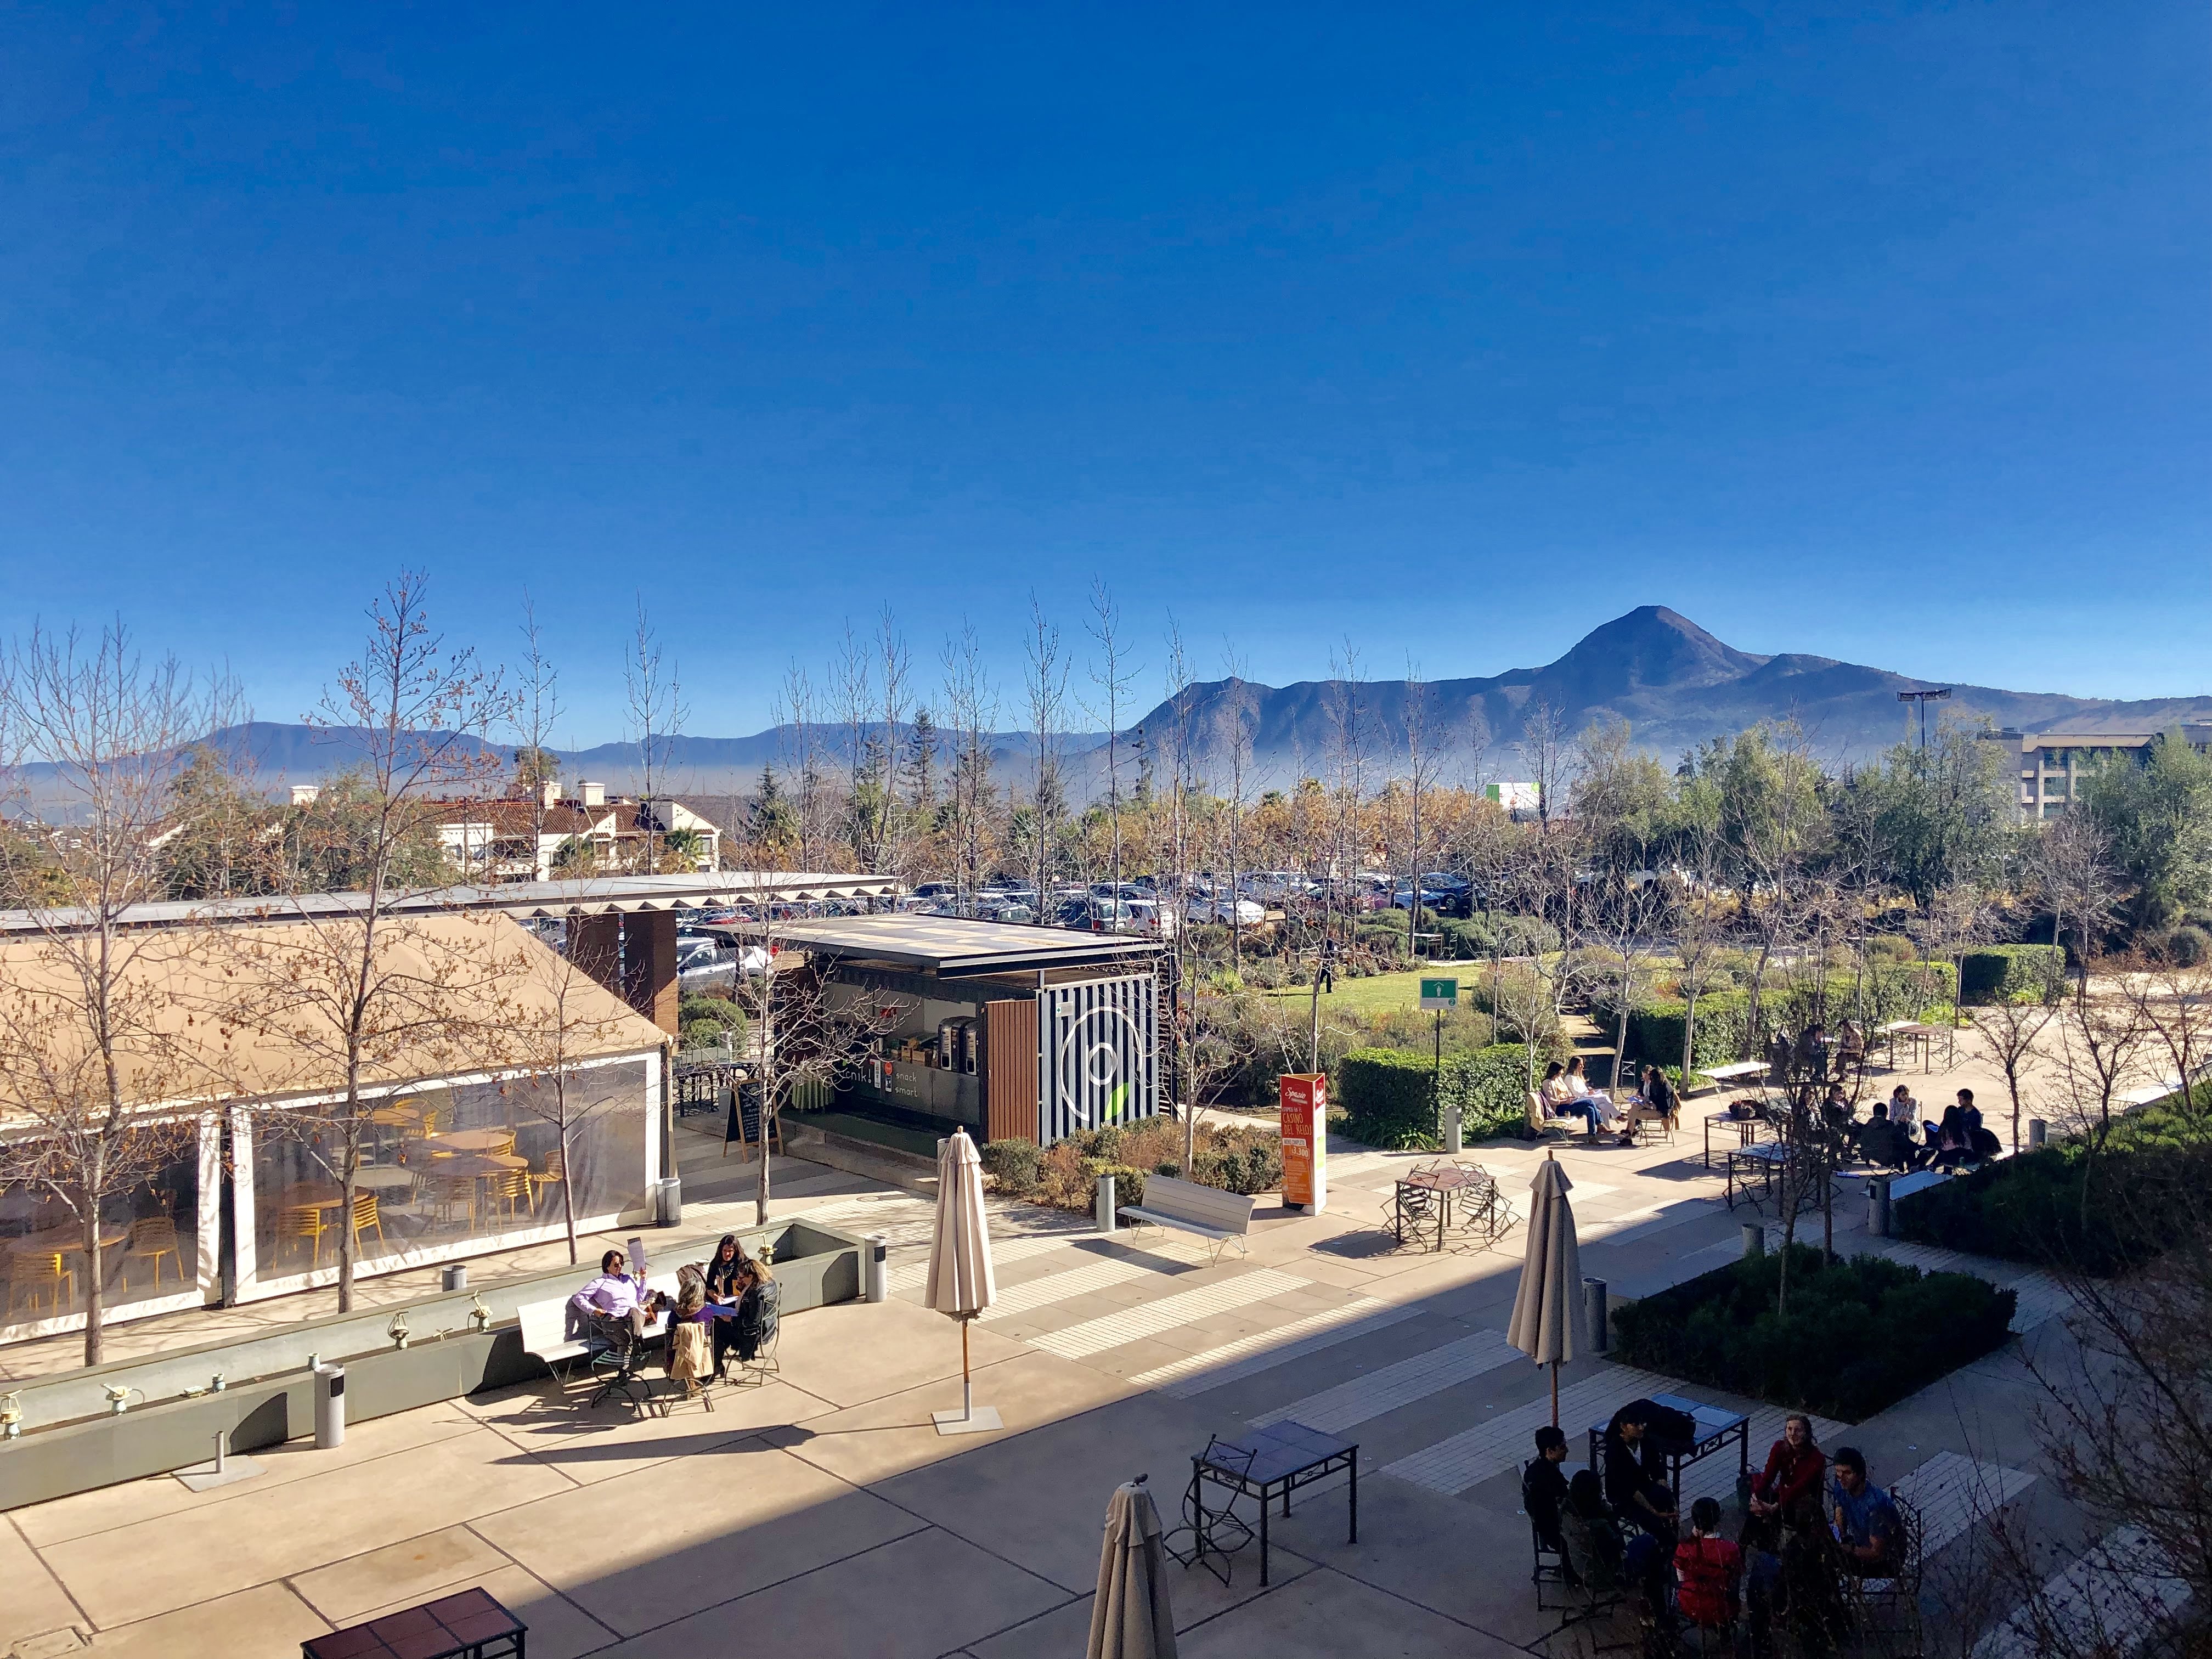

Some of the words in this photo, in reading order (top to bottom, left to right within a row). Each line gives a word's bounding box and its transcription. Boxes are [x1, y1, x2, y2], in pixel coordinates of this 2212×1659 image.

[896, 1072, 917, 1082] snack
[895, 1086, 918, 1097] smart
[1285, 1087, 1306, 1099] Spazio
[1283, 1113, 1304, 1124] CASINO
[1284, 1124, 1294, 1135] DEL
[1296, 1124, 1312, 1136] RELOJ
